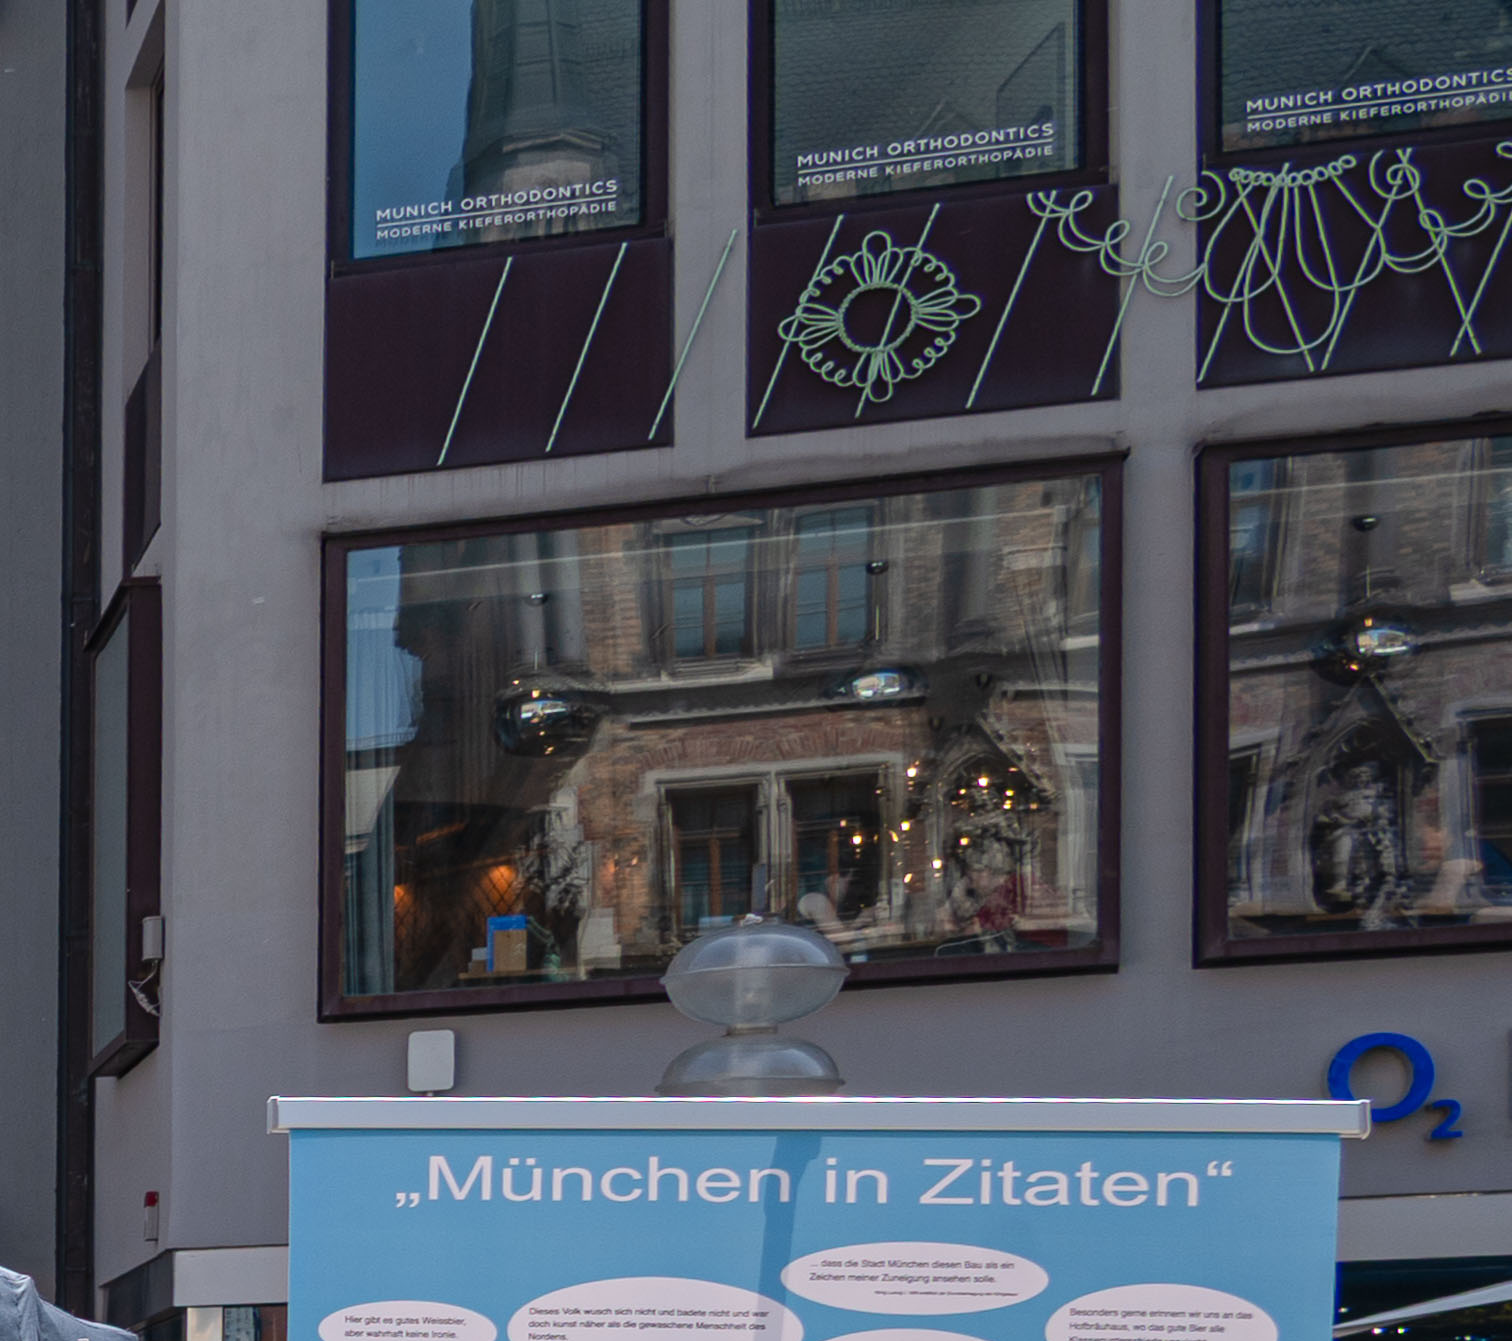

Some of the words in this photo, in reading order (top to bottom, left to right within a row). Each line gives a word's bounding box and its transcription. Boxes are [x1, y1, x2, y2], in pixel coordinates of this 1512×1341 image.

[1246, 90, 1333, 113] MUNICH
[1247, 113, 1332, 132] MODERNE
[797, 145, 879, 168] MUNICH
[887, 123, 1054, 156] ORTHODONTICS
[798, 167, 878, 187] MODERNE
[886, 145, 1053, 176] KIEFERORTHOPÄDIE
[376, 200, 453, 222] MUNICH
[460, 180, 618, 211] ORTHODONTICS
[377, 222, 452, 240] MODERNE
[458, 199, 617, 230] KIEFERORTHOPÄDIE
[396, 1155, 789, 1207] „München
[825, 1157, 888, 1203] in
[919, 1158, 1232, 1206] Zitaten“
